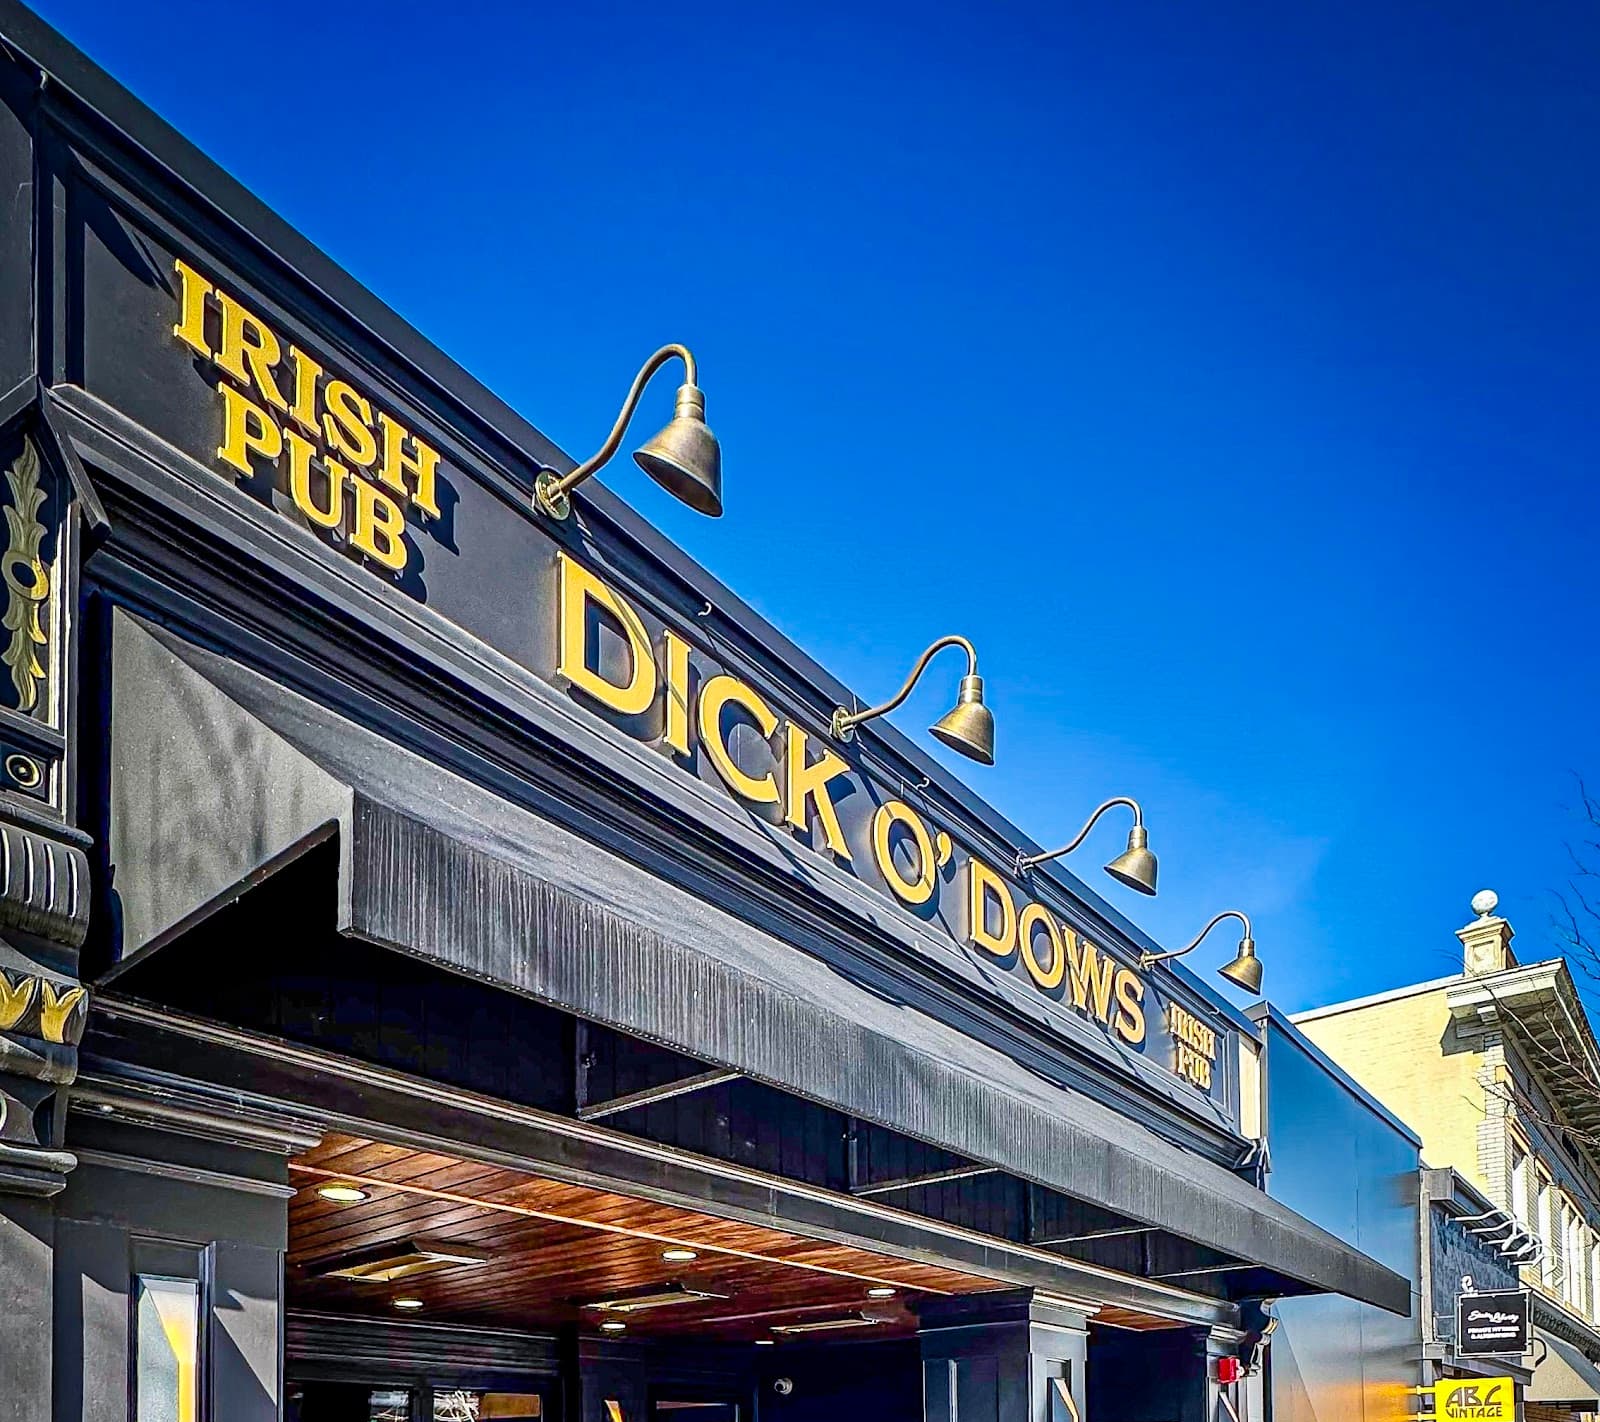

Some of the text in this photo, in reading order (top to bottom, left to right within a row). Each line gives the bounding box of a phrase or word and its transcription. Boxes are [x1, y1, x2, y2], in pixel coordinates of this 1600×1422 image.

[173, 258, 441, 520] IRISH
[217, 381, 408, 570] PUB
[556, 550, 852, 861] DICK
[1169, 1001, 1217, 1061] IRISH
[1177, 1041, 1211, 1090] PUB
[1445, 1385, 1502, 1408] ABC
[1446, 1406, 1503, 1418] VINTAGE
